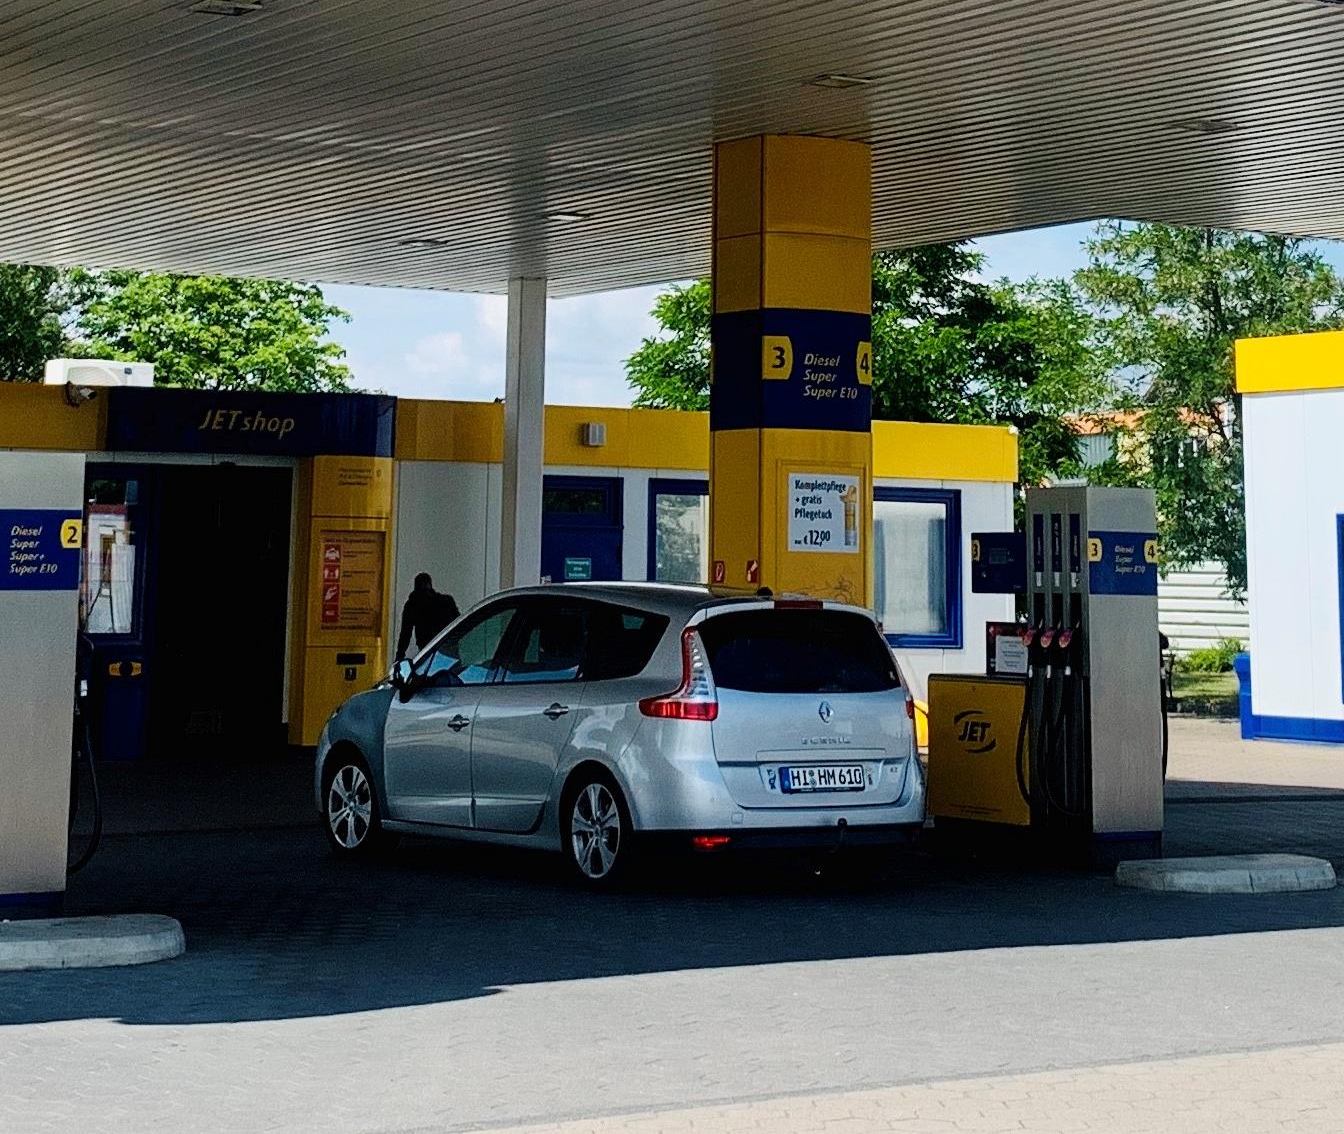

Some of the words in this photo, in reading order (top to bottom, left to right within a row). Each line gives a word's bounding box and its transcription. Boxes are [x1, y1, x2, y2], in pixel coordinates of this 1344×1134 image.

[771, 346, 786, 368] 3
[803, 353, 840, 366] Diesel
[860, 352, 870, 374] 4
[803, 369, 837, 384] Super
[803, 385, 837, 400] Super
[839, 387, 858, 399] E10
[794, 479, 846, 493] Komplettpflege
[801, 495, 823, 506] gratis
[10, 526, 43, 536] Diesel
[67, 526, 78, 543] 2
[9, 538, 41, 550] Super
[1091, 542, 1098, 557] 3
[9, 551, 45, 563] Super+
[1147, 545, 1155, 558] 4
[9, 563, 38, 576] Super
[39, 564, 58, 573] E10
[958, 721, 991, 742] JET
[791, 769, 810, 786] HI
[838, 768, 862, 785] 610
